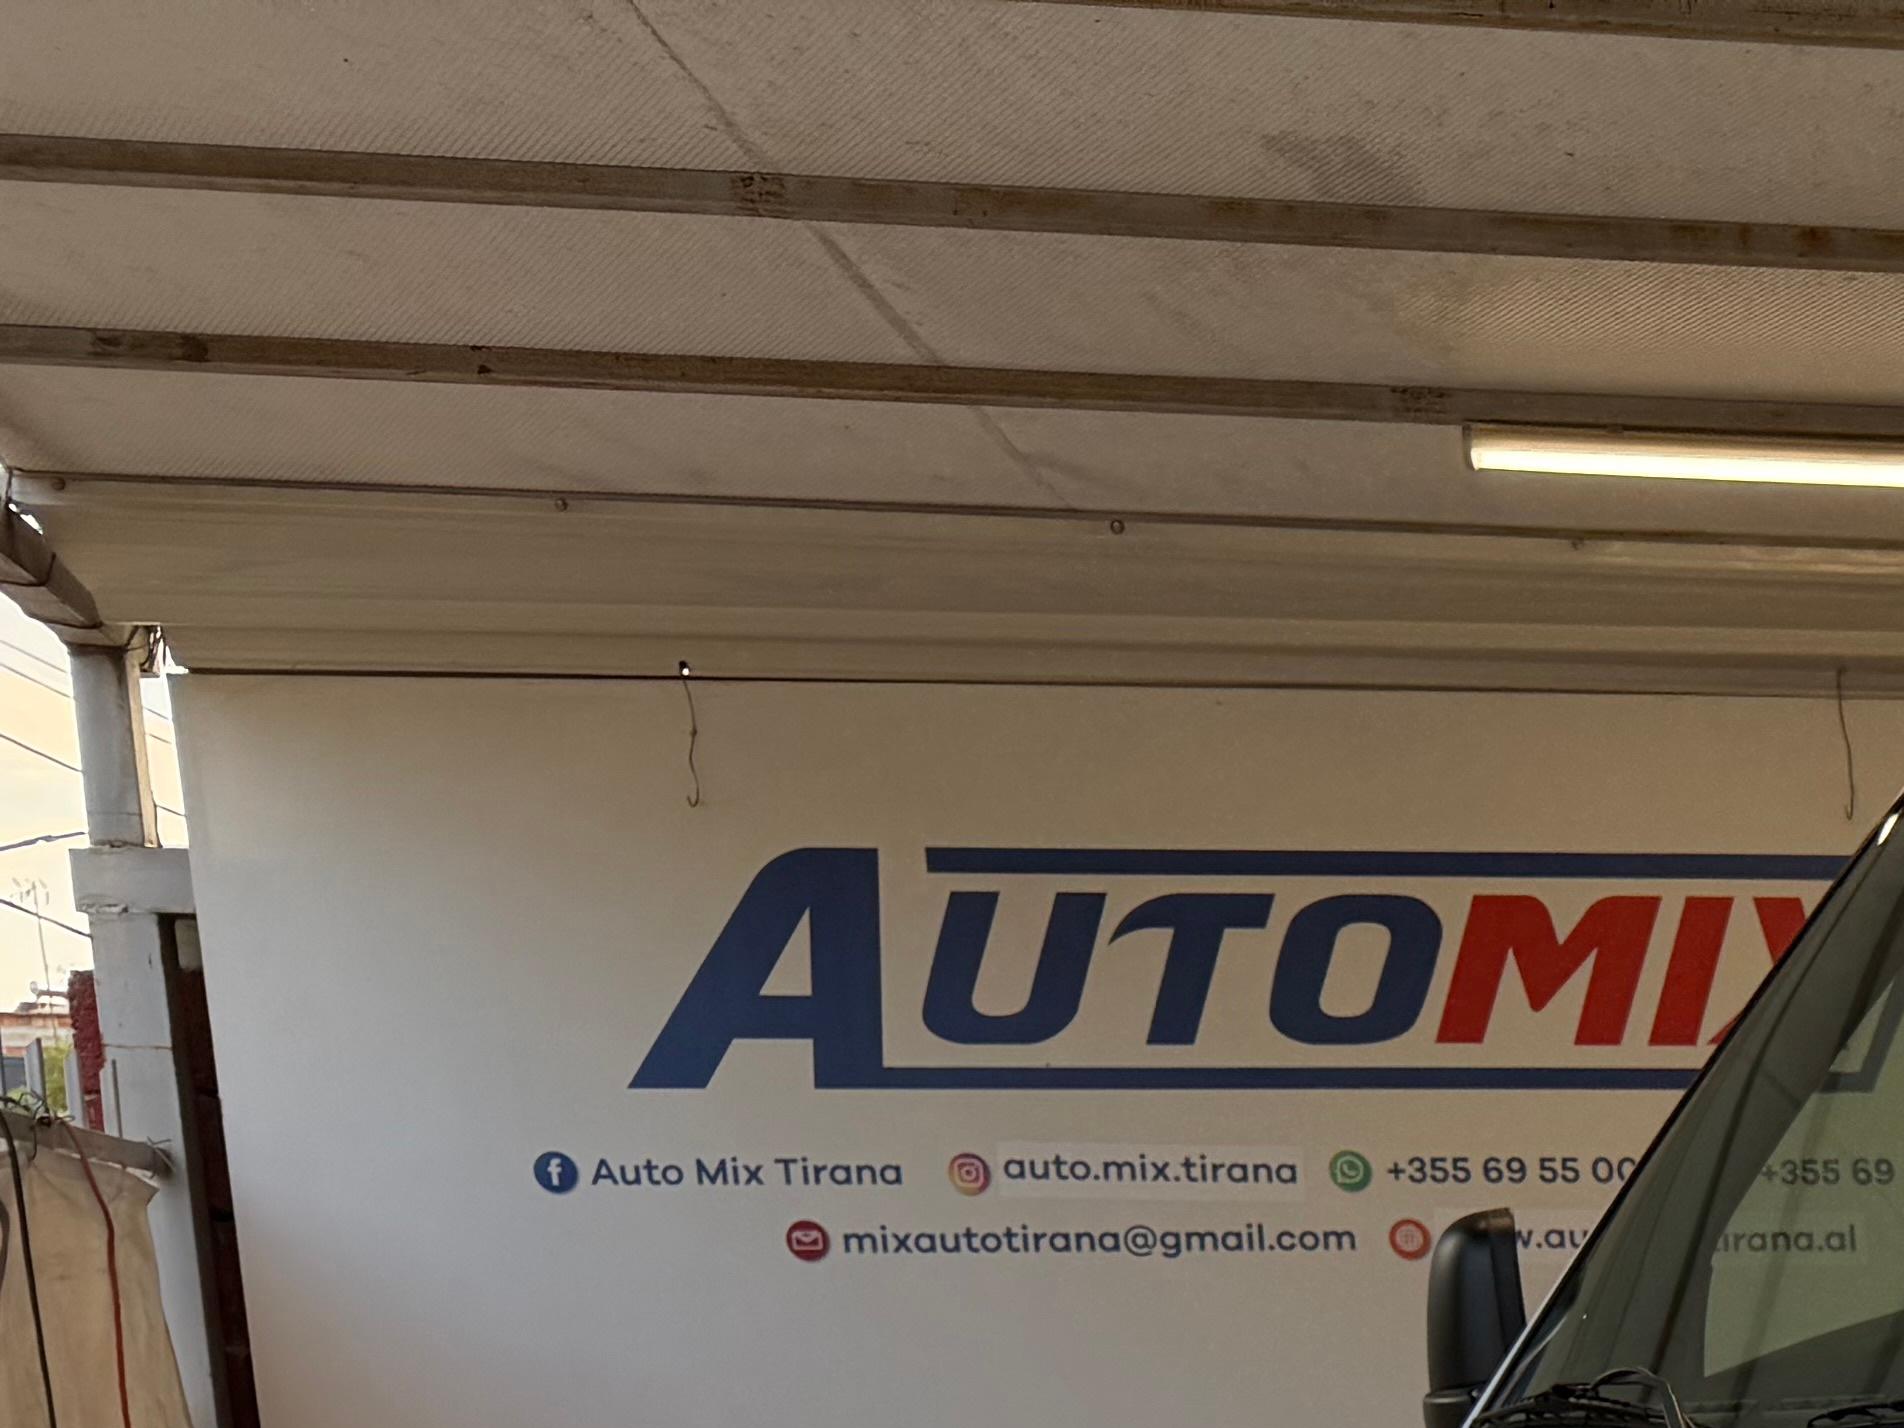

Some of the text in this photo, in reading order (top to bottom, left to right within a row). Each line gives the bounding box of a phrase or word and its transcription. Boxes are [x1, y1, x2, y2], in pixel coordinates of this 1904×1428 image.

[591, 1155, 904, 1187] Auto Mix Tirana
[1002, 1153, 1298, 1185] auto.mix.tirana
[1387, 1155, 1472, 1184] +355
[1482, 1156, 1528, 1184] 69
[1538, 1156, 1581, 1184] 55
[1852, 1158, 1895, 1187] 69
[843, 1223, 1358, 1259] mixautotirana@gmail.com
